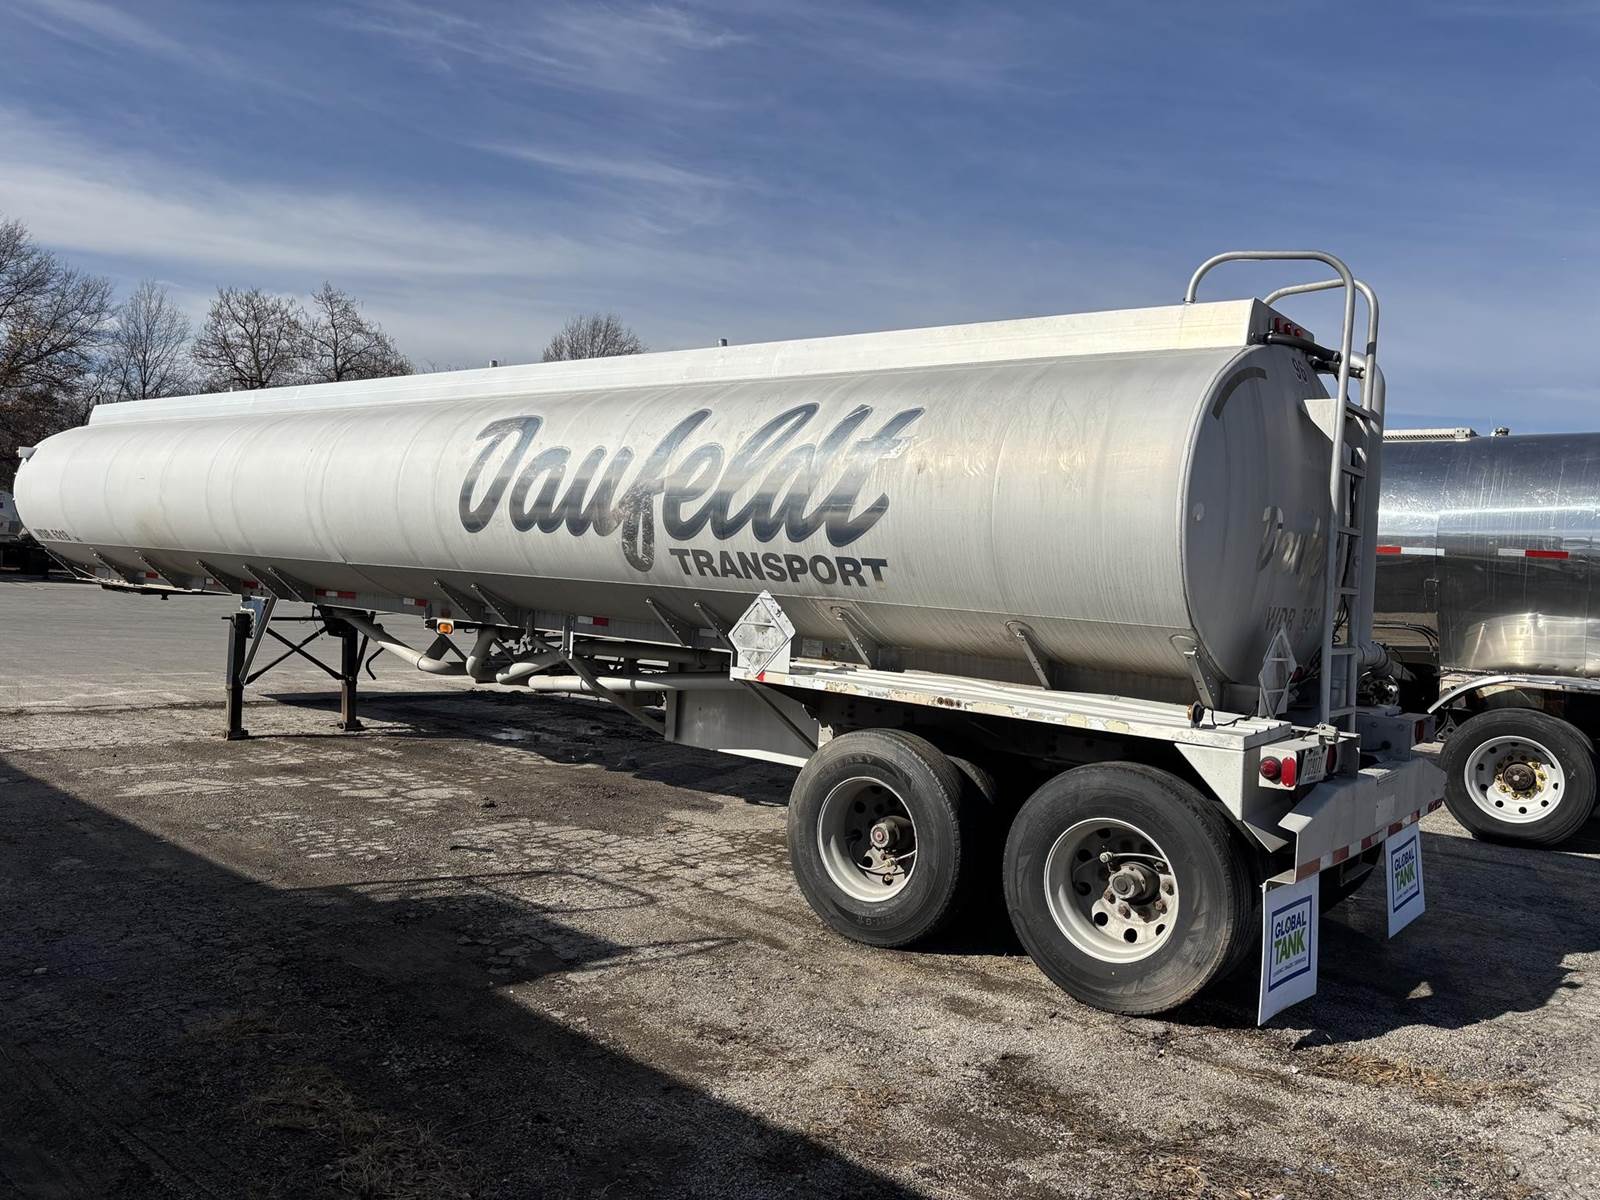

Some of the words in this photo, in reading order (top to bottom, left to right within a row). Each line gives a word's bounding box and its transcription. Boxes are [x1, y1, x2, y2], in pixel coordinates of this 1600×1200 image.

[669, 548, 888, 588] TRANSPORT
[1394, 848, 1415, 871] GLOBAL
[1394, 861, 1416, 891] TANK
[1274, 911, 1307, 938] GLOBAL
[1274, 927, 1307, 965] TANK
